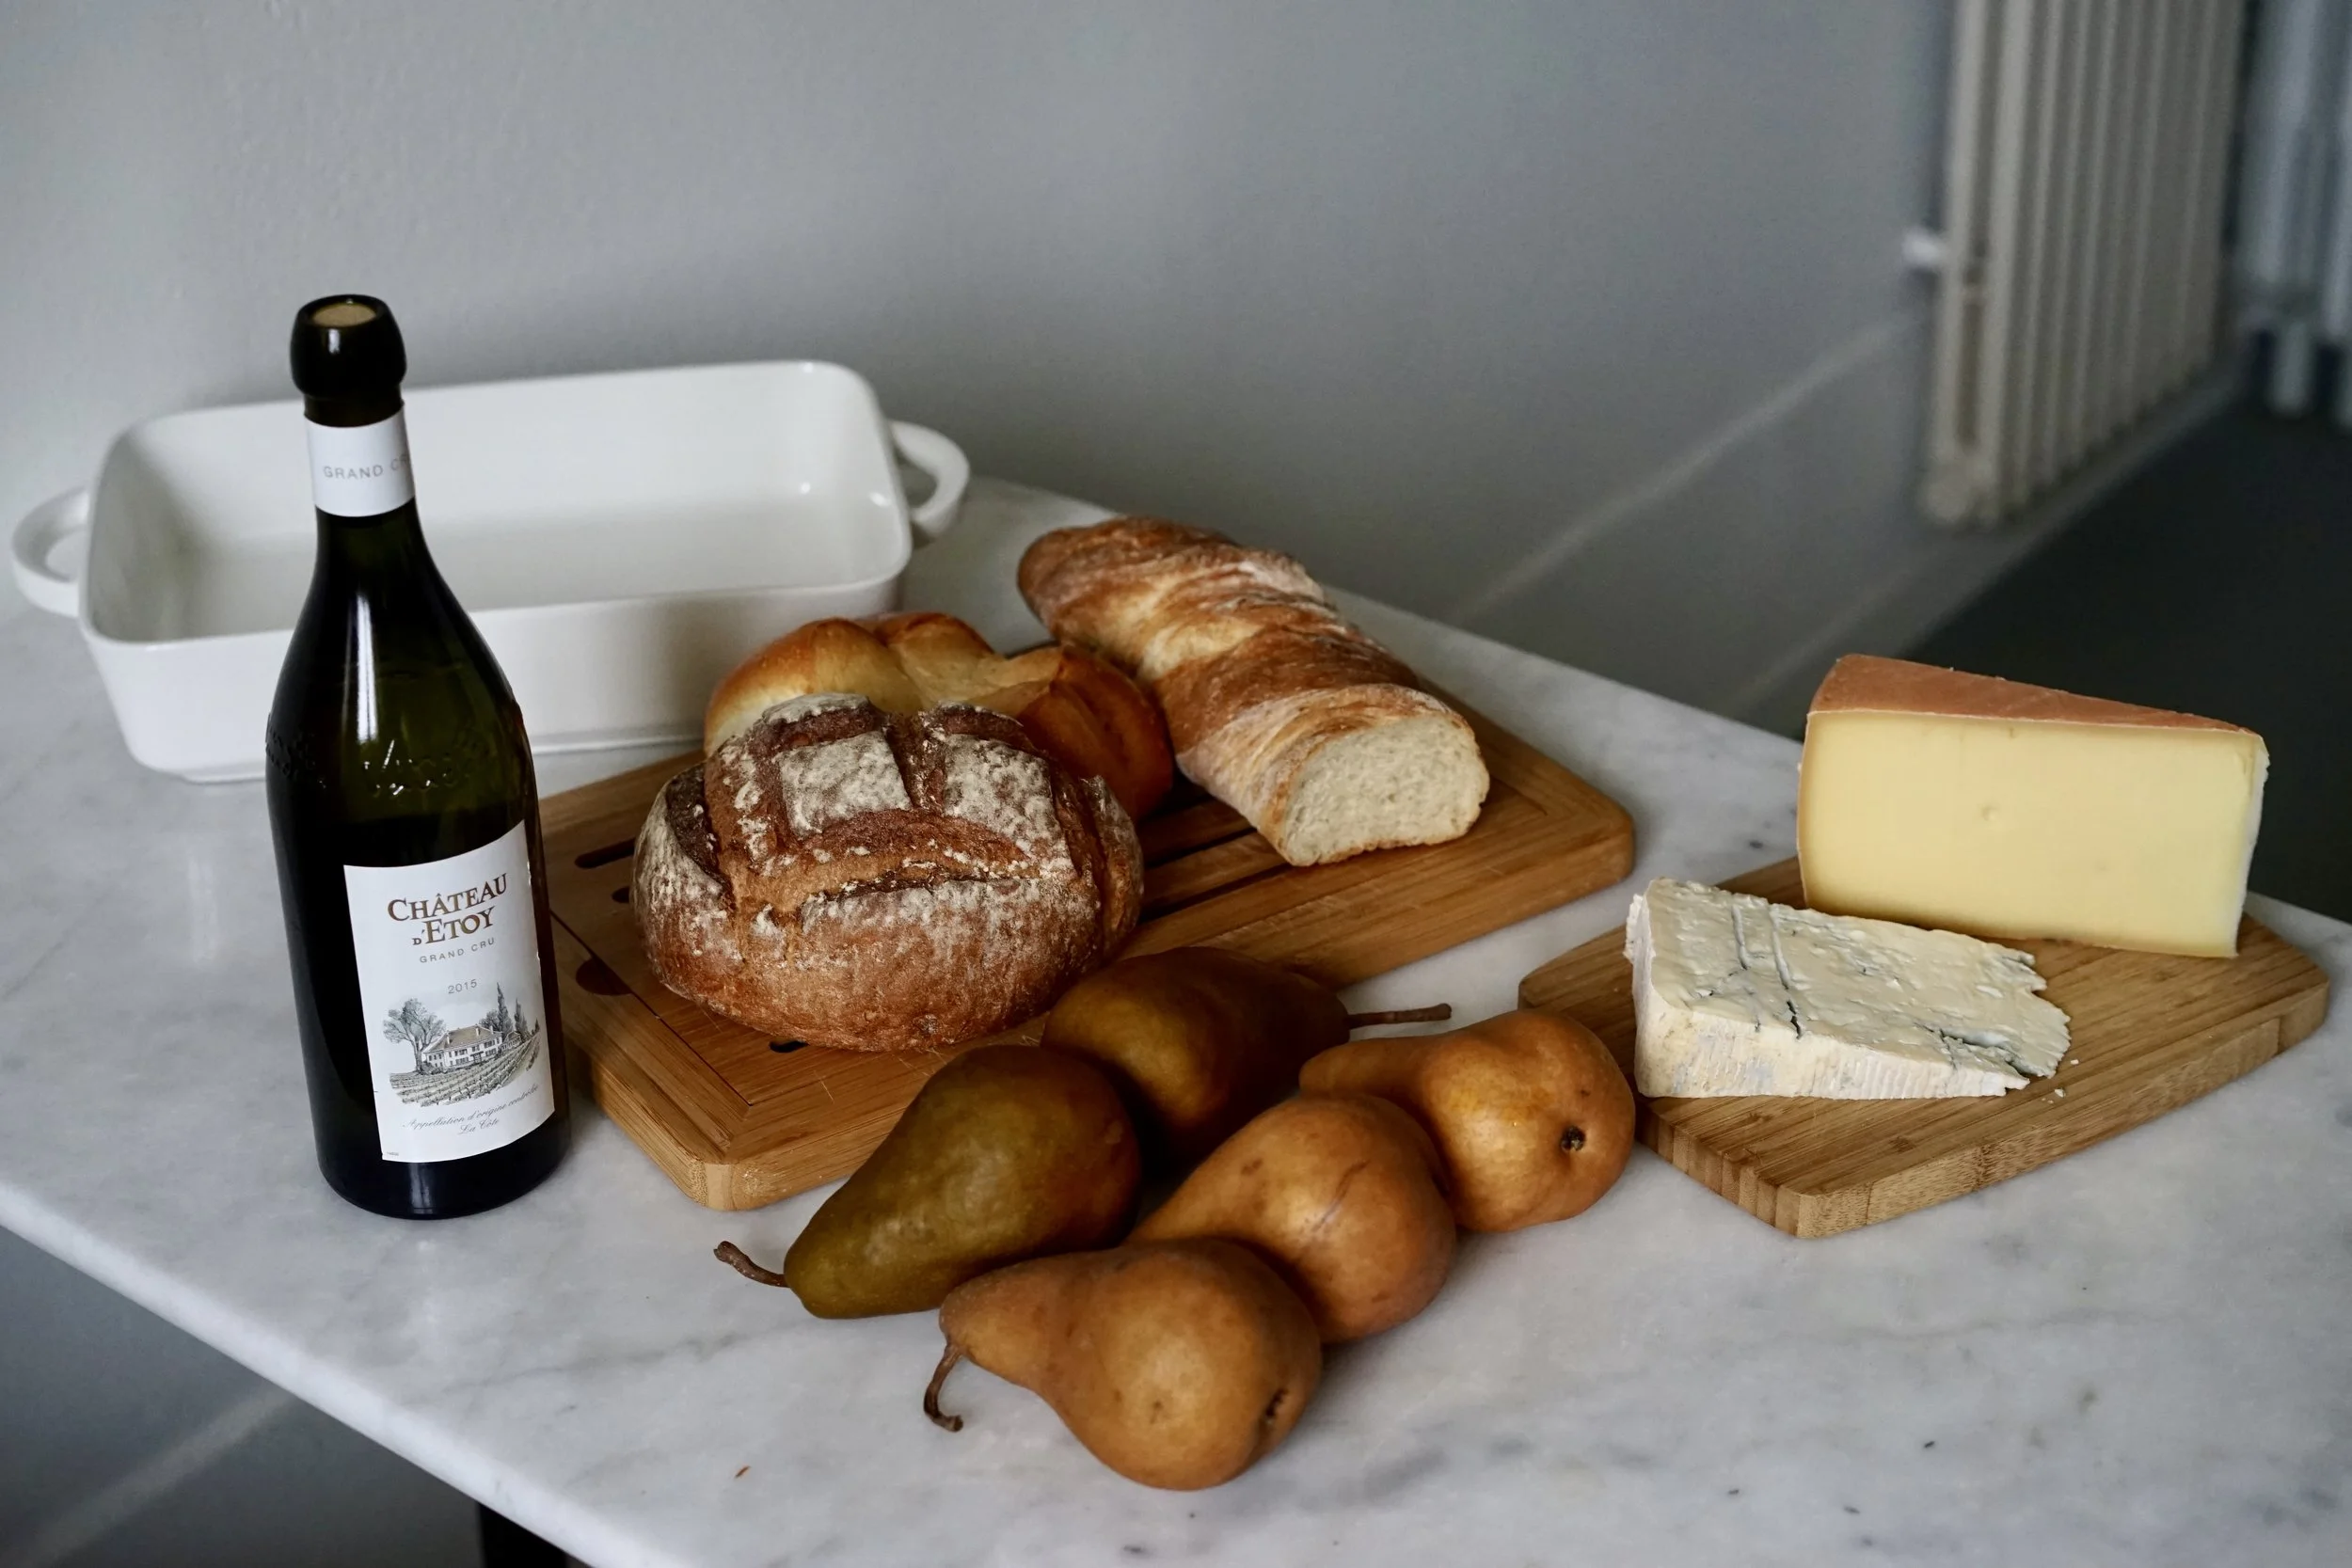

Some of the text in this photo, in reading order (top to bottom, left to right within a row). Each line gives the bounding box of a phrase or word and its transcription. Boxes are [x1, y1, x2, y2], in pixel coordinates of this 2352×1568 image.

[323, 466, 384, 479] GRAND
[387, 873, 507, 922] CHÂTEAU
[420, 937, 495, 963] GRAND CRU
[448, 978, 478, 994] 2015
[403, 1117, 465, 1131] Appellation
[457, 1123, 476, 1135] La
